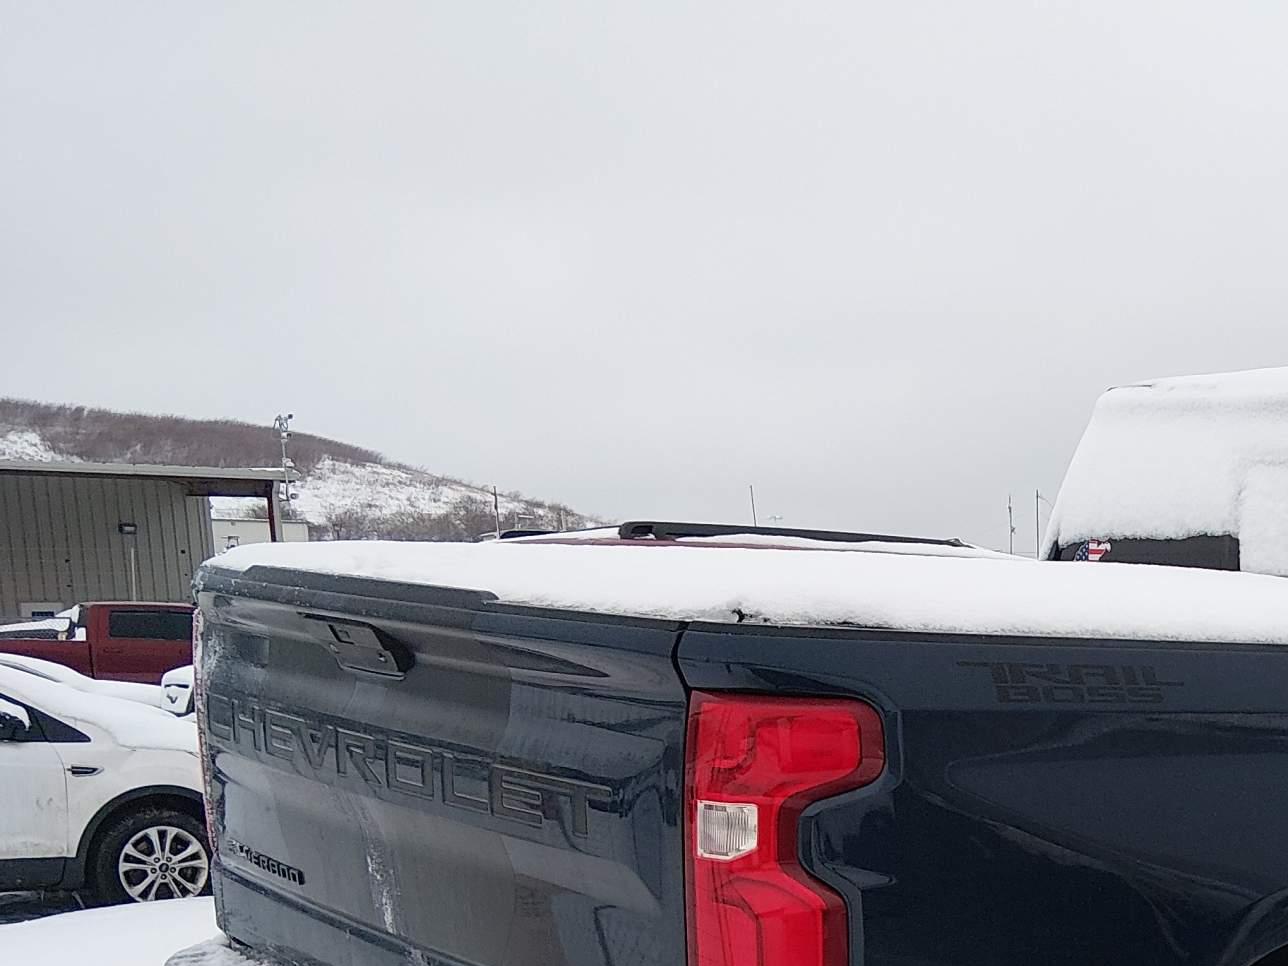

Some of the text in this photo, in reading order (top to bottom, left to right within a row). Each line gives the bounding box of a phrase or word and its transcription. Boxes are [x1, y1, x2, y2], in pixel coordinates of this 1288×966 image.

[957, 661, 1185, 687] TRAIL
[995, 685, 1165, 703] BOSS
[206, 693, 612, 839] CHEVROLET
